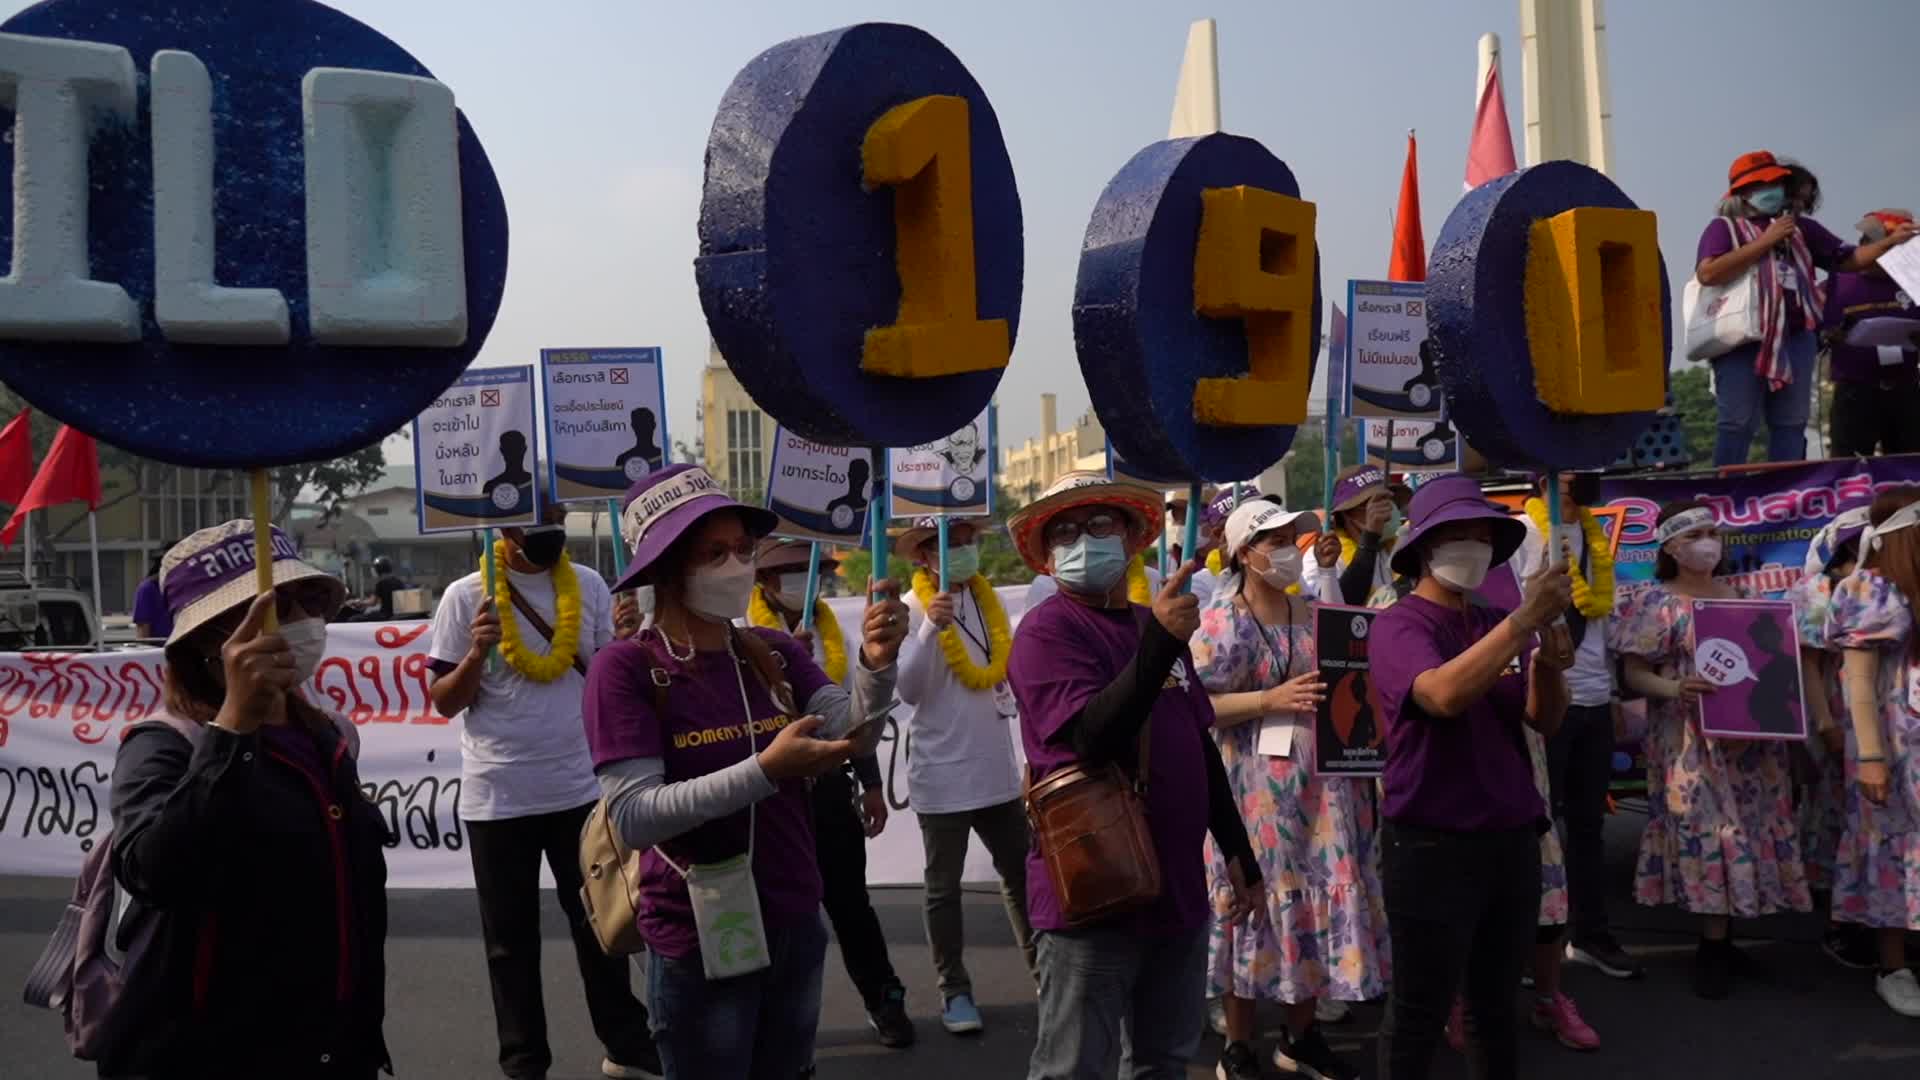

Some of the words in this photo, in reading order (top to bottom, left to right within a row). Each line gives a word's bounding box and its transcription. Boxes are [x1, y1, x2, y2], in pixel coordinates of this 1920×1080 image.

[0, 33, 469, 347] ILO
[861, 94, 1011, 378] 1
[1193, 185, 1317, 425] 9
[552, 369, 606, 385] เลือกเราสิ
[432, 414, 480, 433] จะเข้าไป
[435, 441, 480, 460] นั่งหลับ
[439, 467, 478, 487] ในสภา
[782, 463, 847, 485] เขากระโดง
[1710, 649, 1736, 669] ILO
[1703, 662, 1727, 682] 183
[673, 726, 743, 749] WOMEN'S
